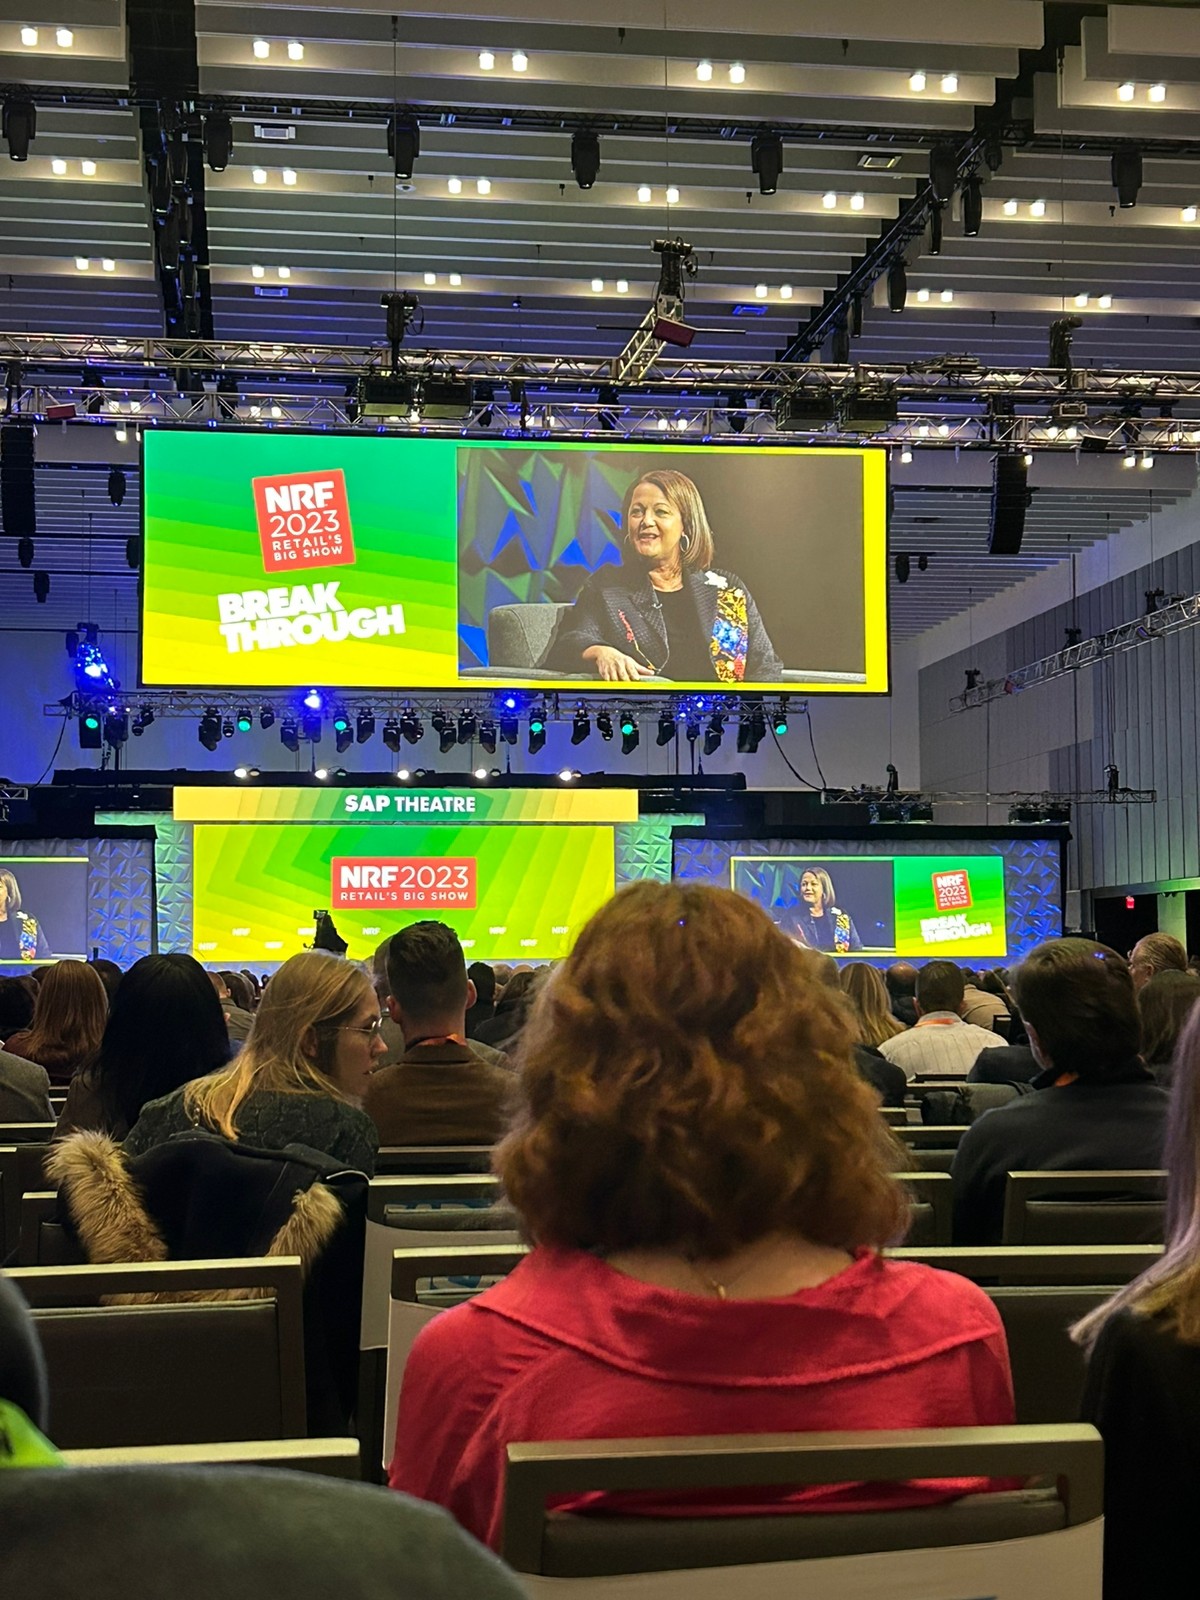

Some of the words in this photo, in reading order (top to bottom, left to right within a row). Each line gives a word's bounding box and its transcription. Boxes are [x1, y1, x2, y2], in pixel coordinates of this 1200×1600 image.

[265, 481, 334, 513] NRF
[269, 509, 340, 538] 2023
[272, 534, 342, 551] RETAIL'S
[274, 550, 297, 562] BIG
[303, 546, 343, 558] SHOW
[217, 581, 345, 624] BREAK
[219, 603, 406, 653] THROUGH
[344, 794, 391, 812] SAP
[394, 796, 476, 812] THEATRE
[340, 865, 398, 889] NRF
[399, 865, 469, 889] 2023
[936, 873, 965, 888] NRF
[340, 891, 398, 901] RETAIL'S
[403, 891, 425, 901] BIG
[431, 891, 469, 901] SHOW
[938, 885, 967, 898] 2023
[920, 913, 969, 932] BREAK
[920, 922, 993, 944] THROUGH
